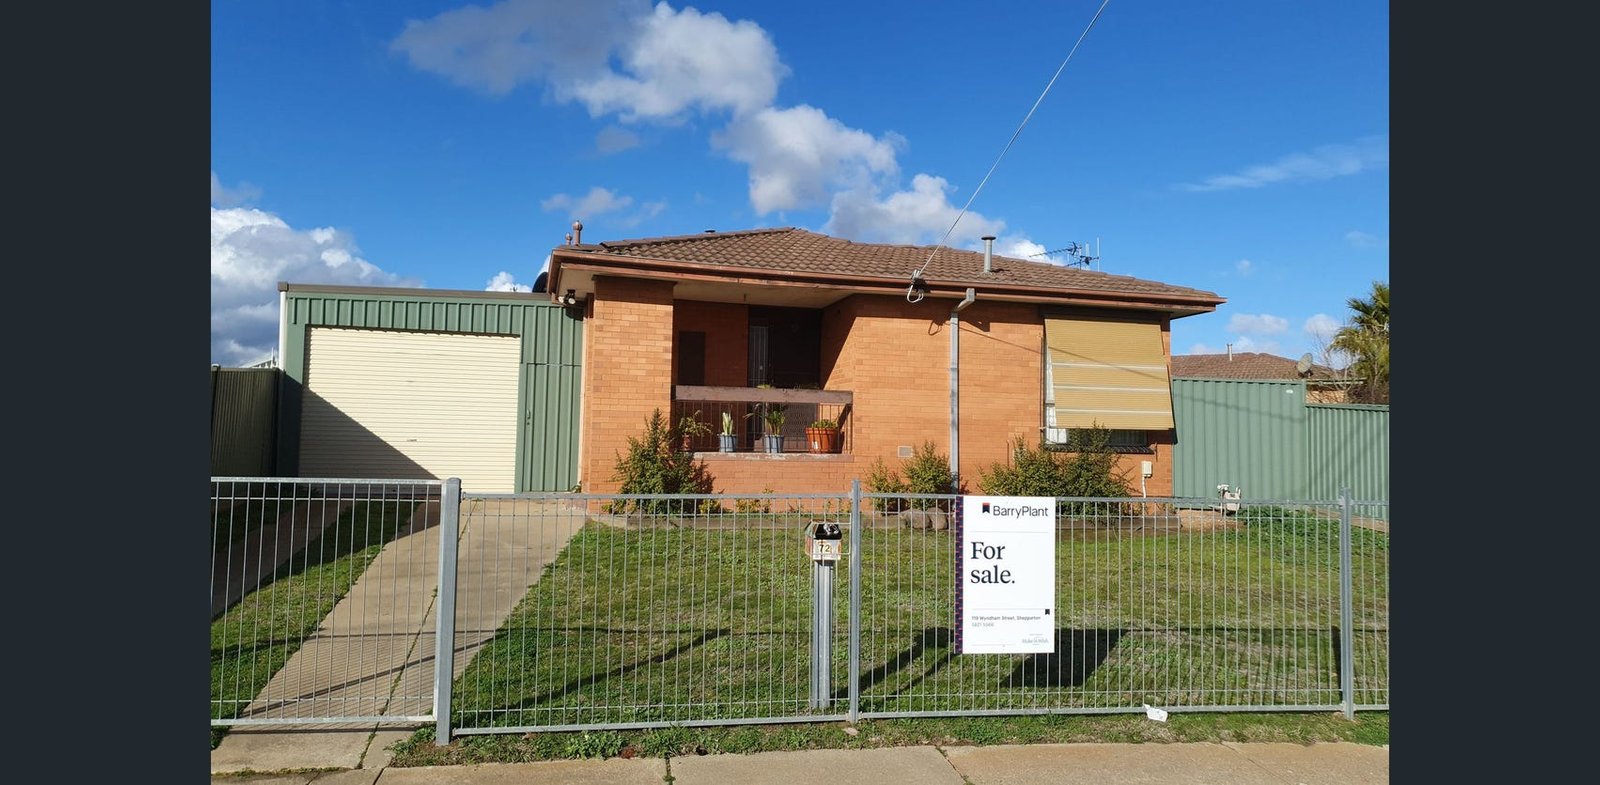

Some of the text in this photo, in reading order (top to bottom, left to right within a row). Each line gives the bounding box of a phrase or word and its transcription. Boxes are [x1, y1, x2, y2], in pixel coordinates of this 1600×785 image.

[993, 505, 1048, 518] BarryPlant
[819, 544, 830, 552] 72
[971, 541, 1005, 560] For
[970, 565, 1015, 584] sale.
